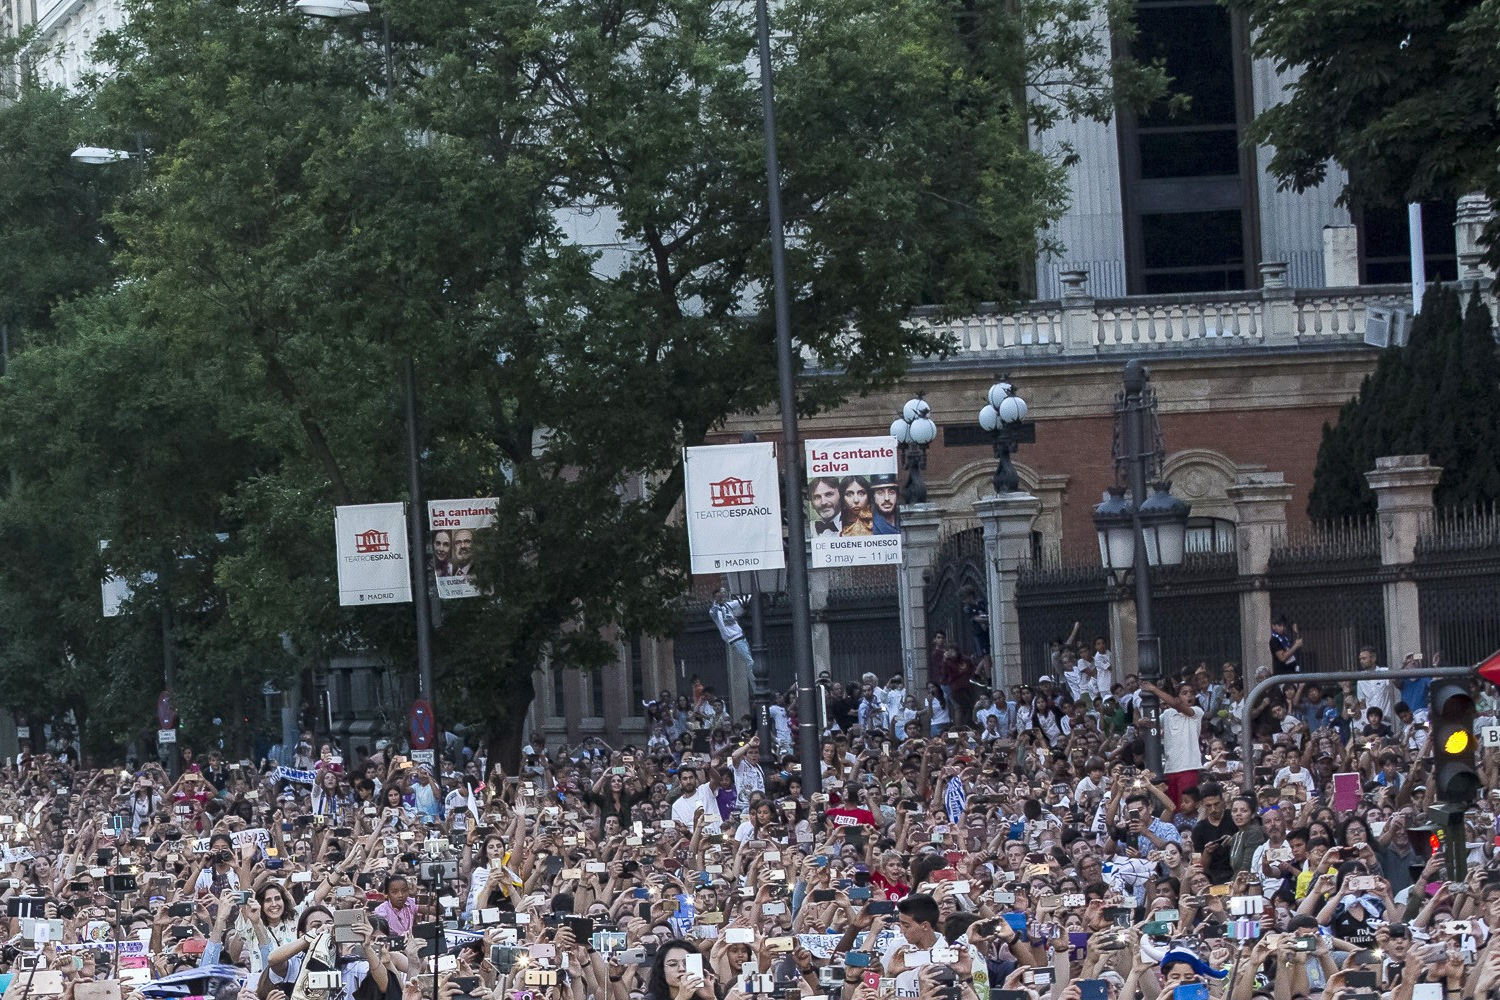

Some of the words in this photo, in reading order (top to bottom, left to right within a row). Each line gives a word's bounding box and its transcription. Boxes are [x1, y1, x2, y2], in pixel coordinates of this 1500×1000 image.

[811, 450, 829, 461] La
[832, 447, 894, 460] cantante
[812, 462, 849, 473] calva
[431, 508, 446, 518] La
[432, 517, 461, 527] calva
[815, 542, 826, 550] DE
[829, 540, 863, 550] EUGÈNE
[863, 539, 898, 548] IONESCO
[725, 558, 760, 568] MADRID
[825, 553, 832, 563] 3
[834, 554, 855, 565] may
[871, 551, 881, 561] 11
[884, 551, 898, 563] jun
[367, 592, 395, 601] MADRID
[280, 767, 316, 780] CAMPEO
